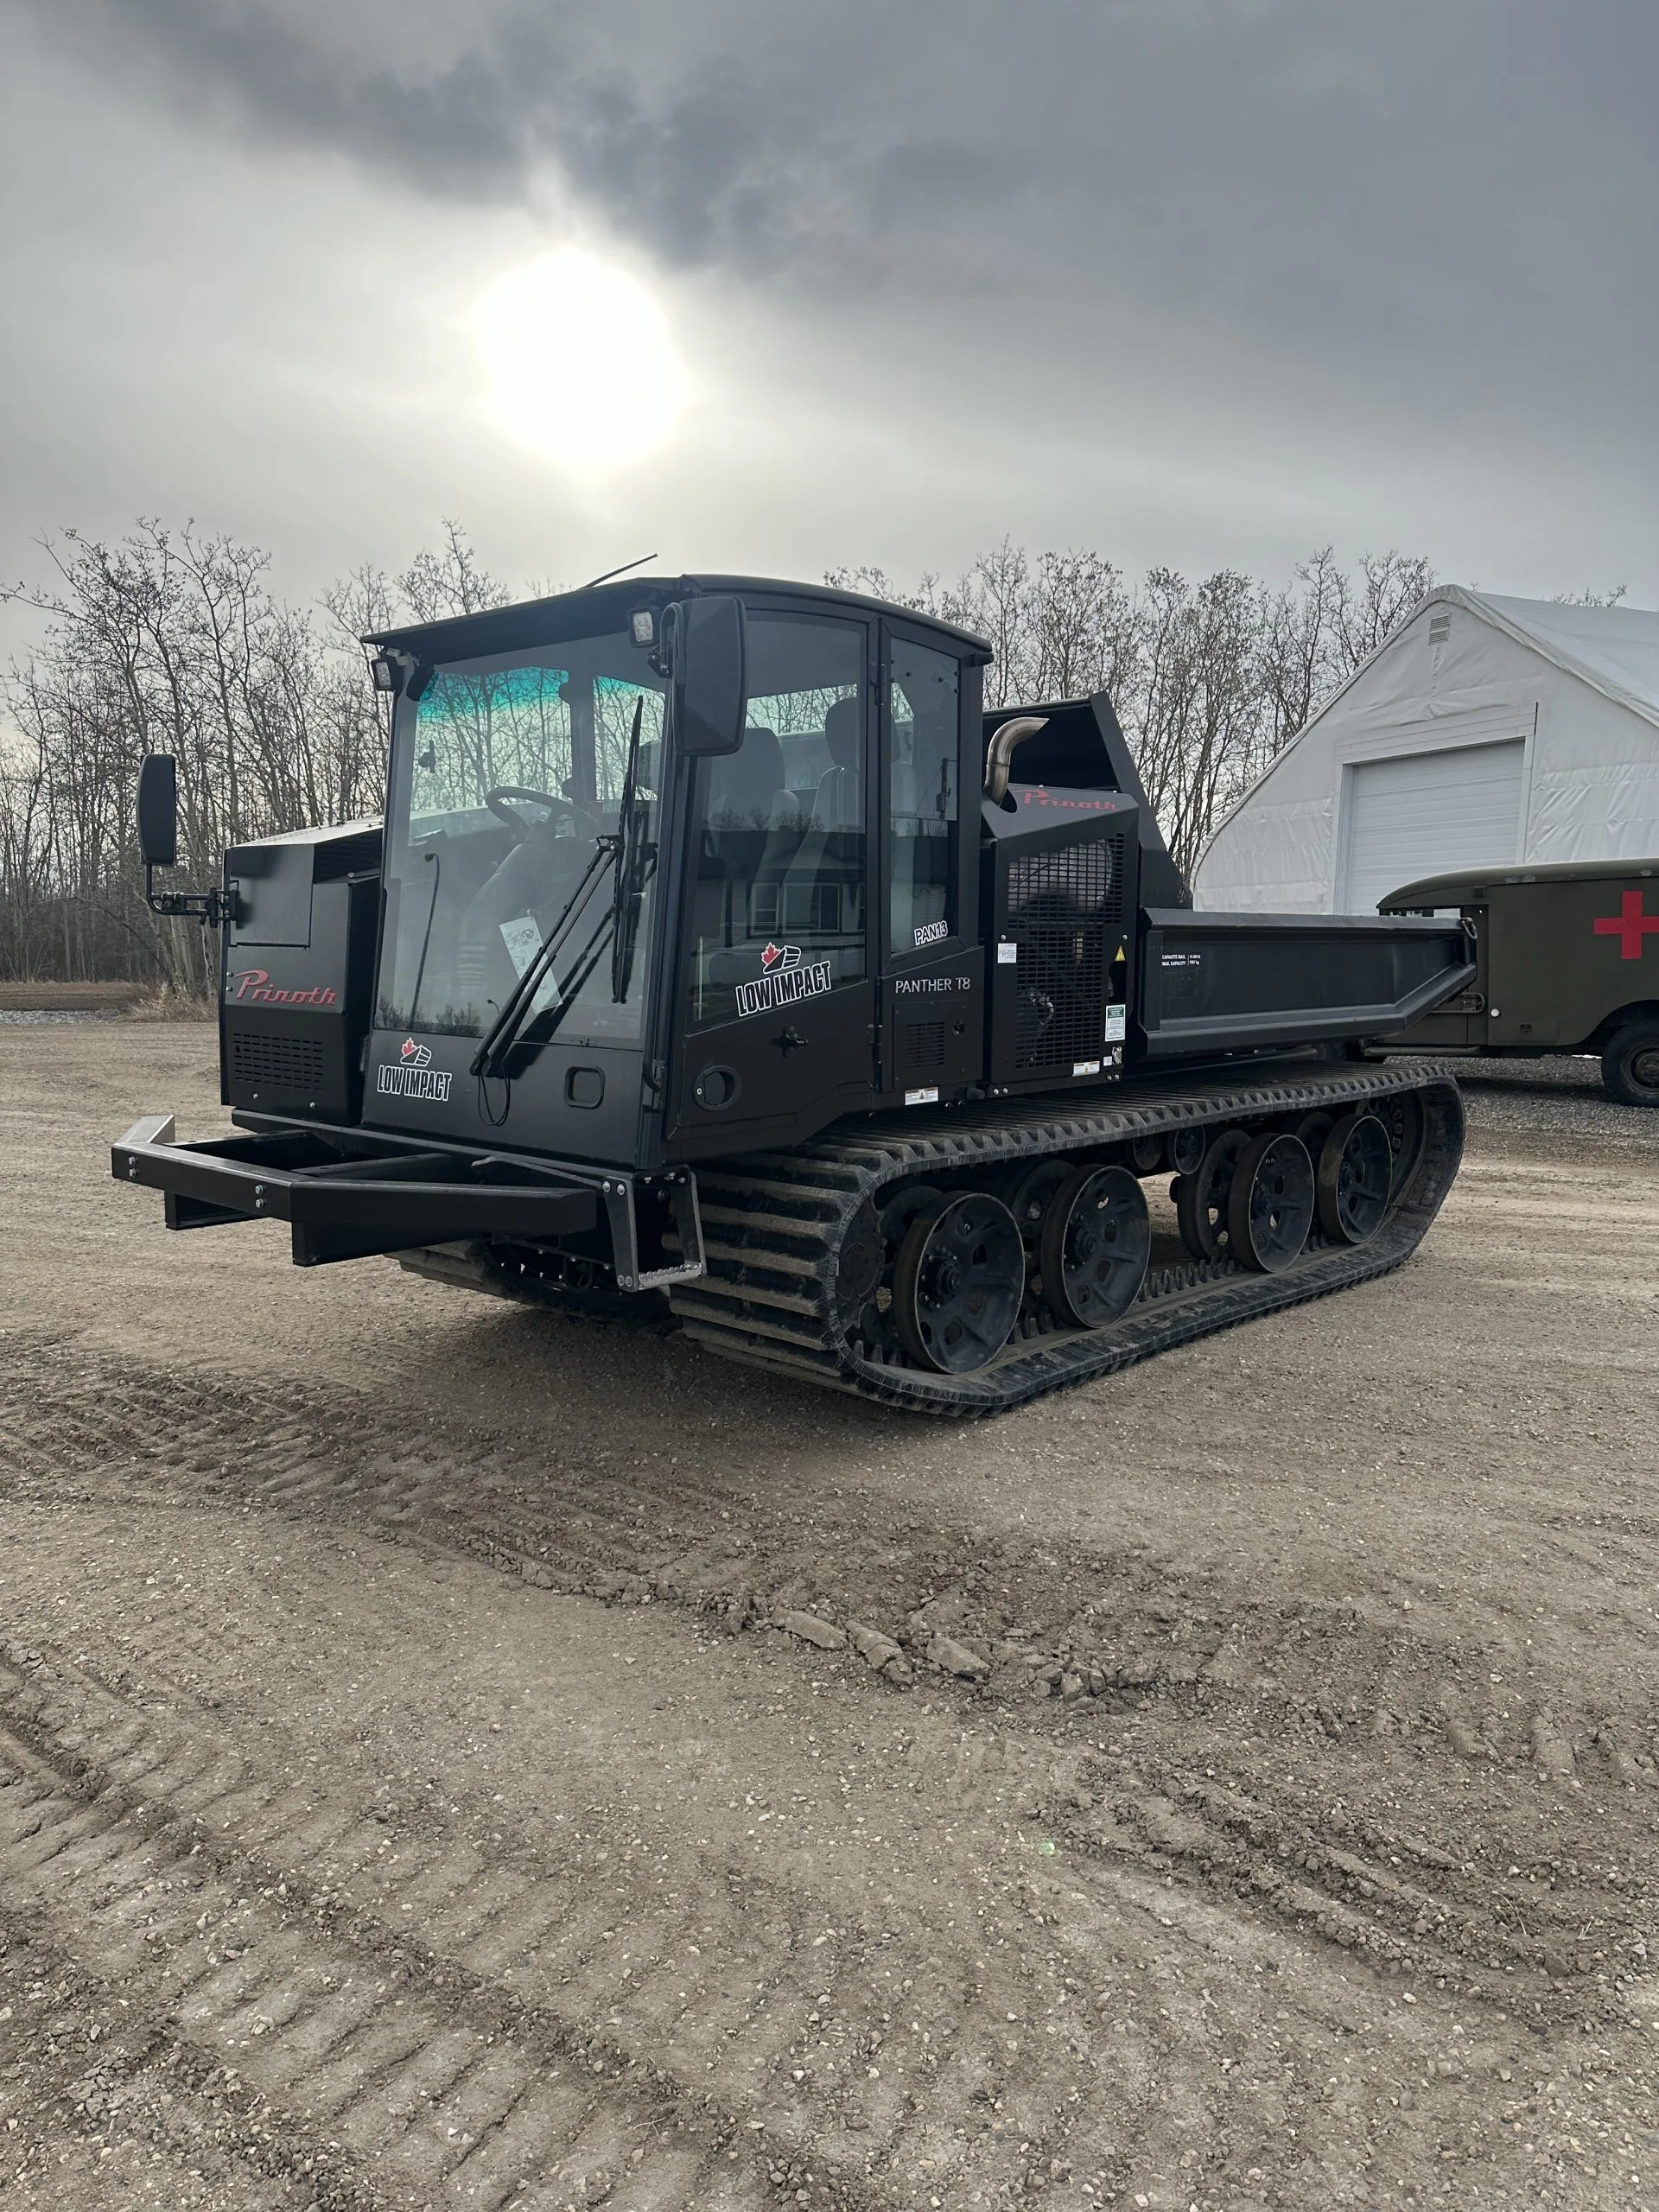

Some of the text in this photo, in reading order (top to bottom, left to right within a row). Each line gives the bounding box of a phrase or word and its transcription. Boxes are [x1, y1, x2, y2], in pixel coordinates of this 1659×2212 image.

[1013, 790, 1118, 812] Prinoth
[914, 920, 948, 946] PAN13
[234, 969, 337, 1006] Prinoth
[735, 961, 831, 1016] LOW IMPACT
[895, 977, 970, 994] PANTHER T8
[378, 1065, 452, 1101] LOW IMPACT
